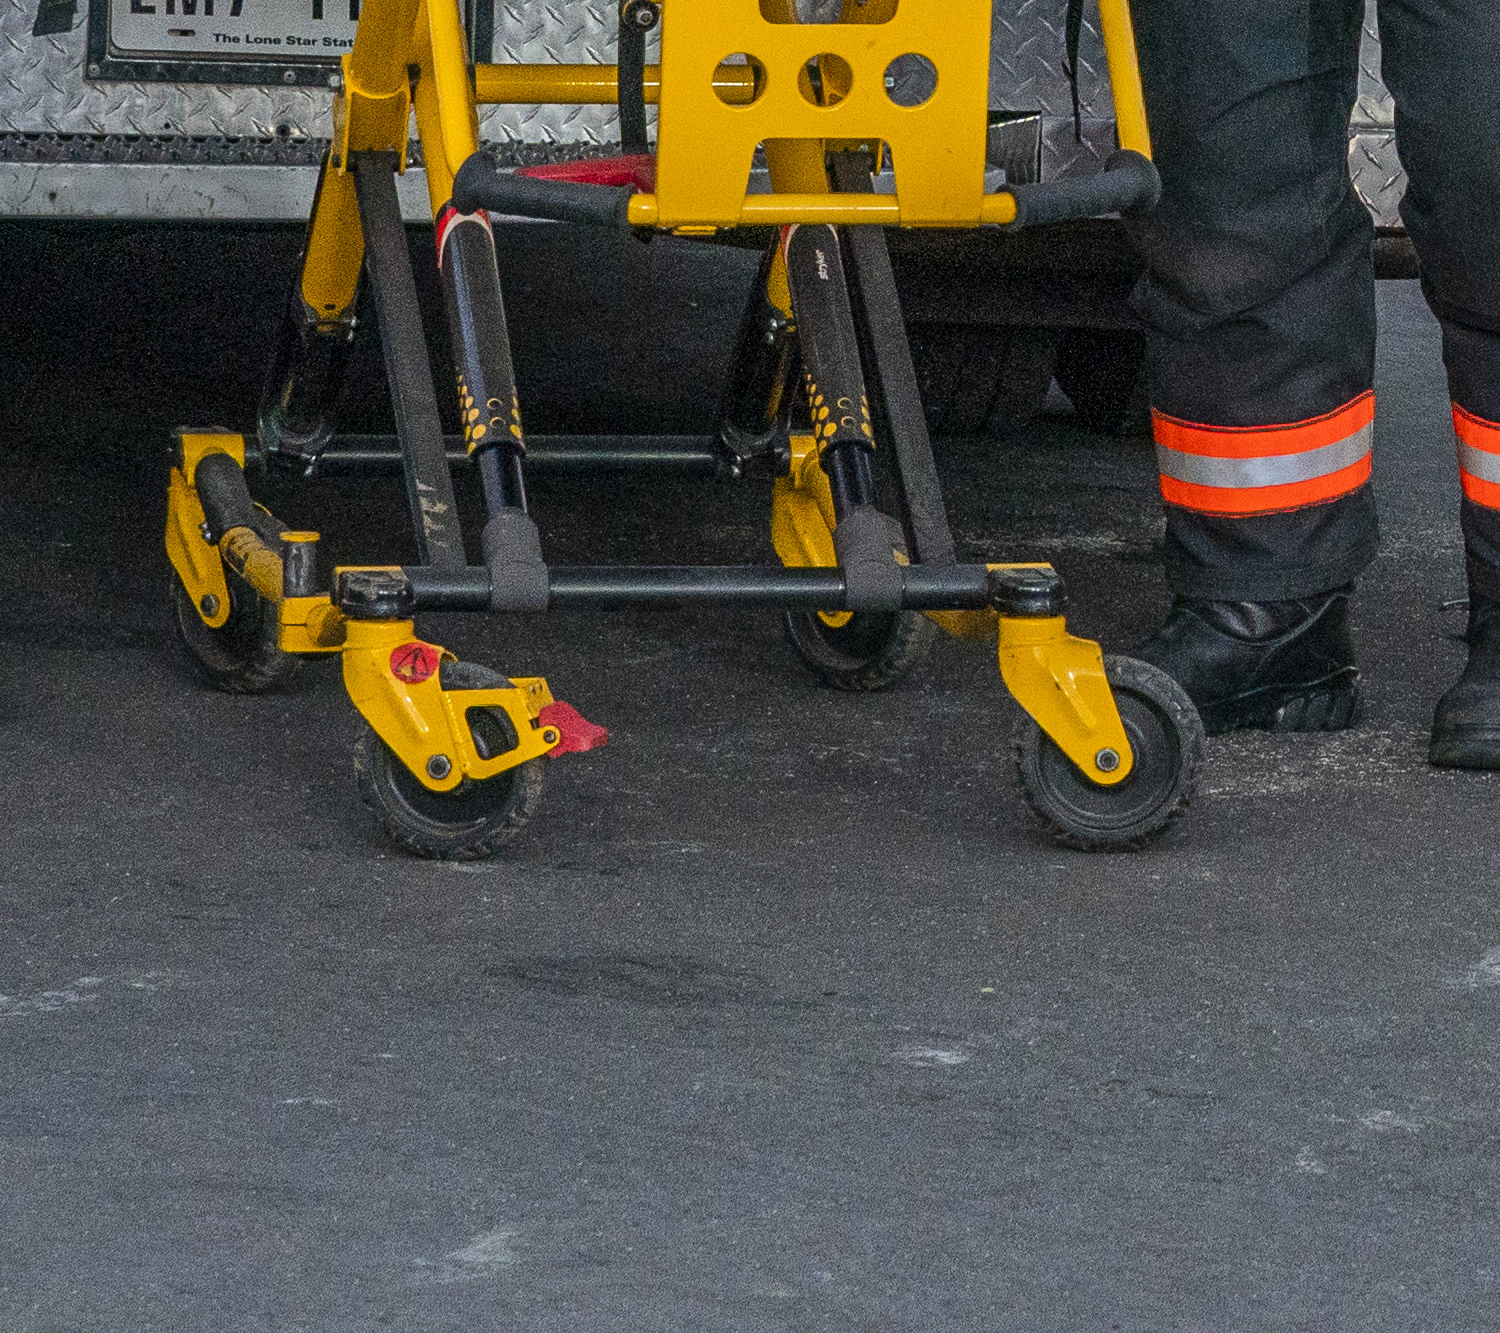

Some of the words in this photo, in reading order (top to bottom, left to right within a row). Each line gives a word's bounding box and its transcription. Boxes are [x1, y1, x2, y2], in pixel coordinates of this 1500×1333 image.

[213, 33, 241, 44] The
[245, 34, 282, 45] Lone
[286, 35, 318, 46] Star
